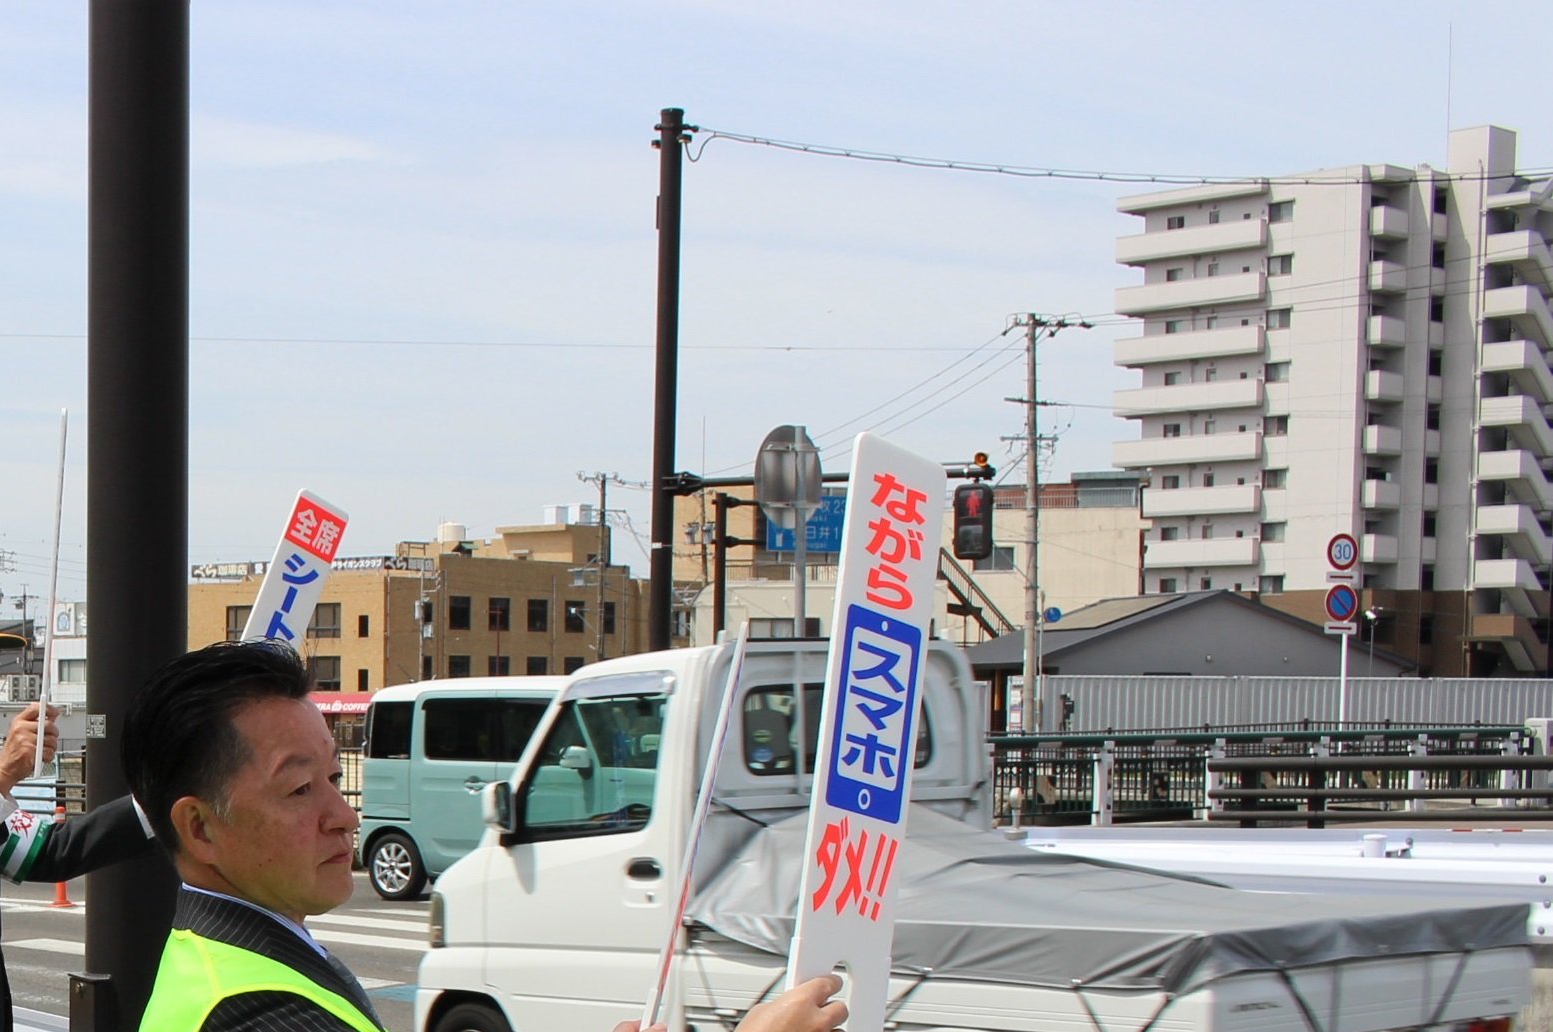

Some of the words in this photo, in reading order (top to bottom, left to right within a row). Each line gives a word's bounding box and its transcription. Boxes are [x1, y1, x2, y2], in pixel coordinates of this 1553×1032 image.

[290, 509, 340, 555] 全席
[865, 473, 927, 610] ながら
[1334, 543, 1353, 561] 30
[264, 553, 320, 641] シート
[841, 641, 904, 778] スマホ
[812, 815, 899, 922] ダメ!!
